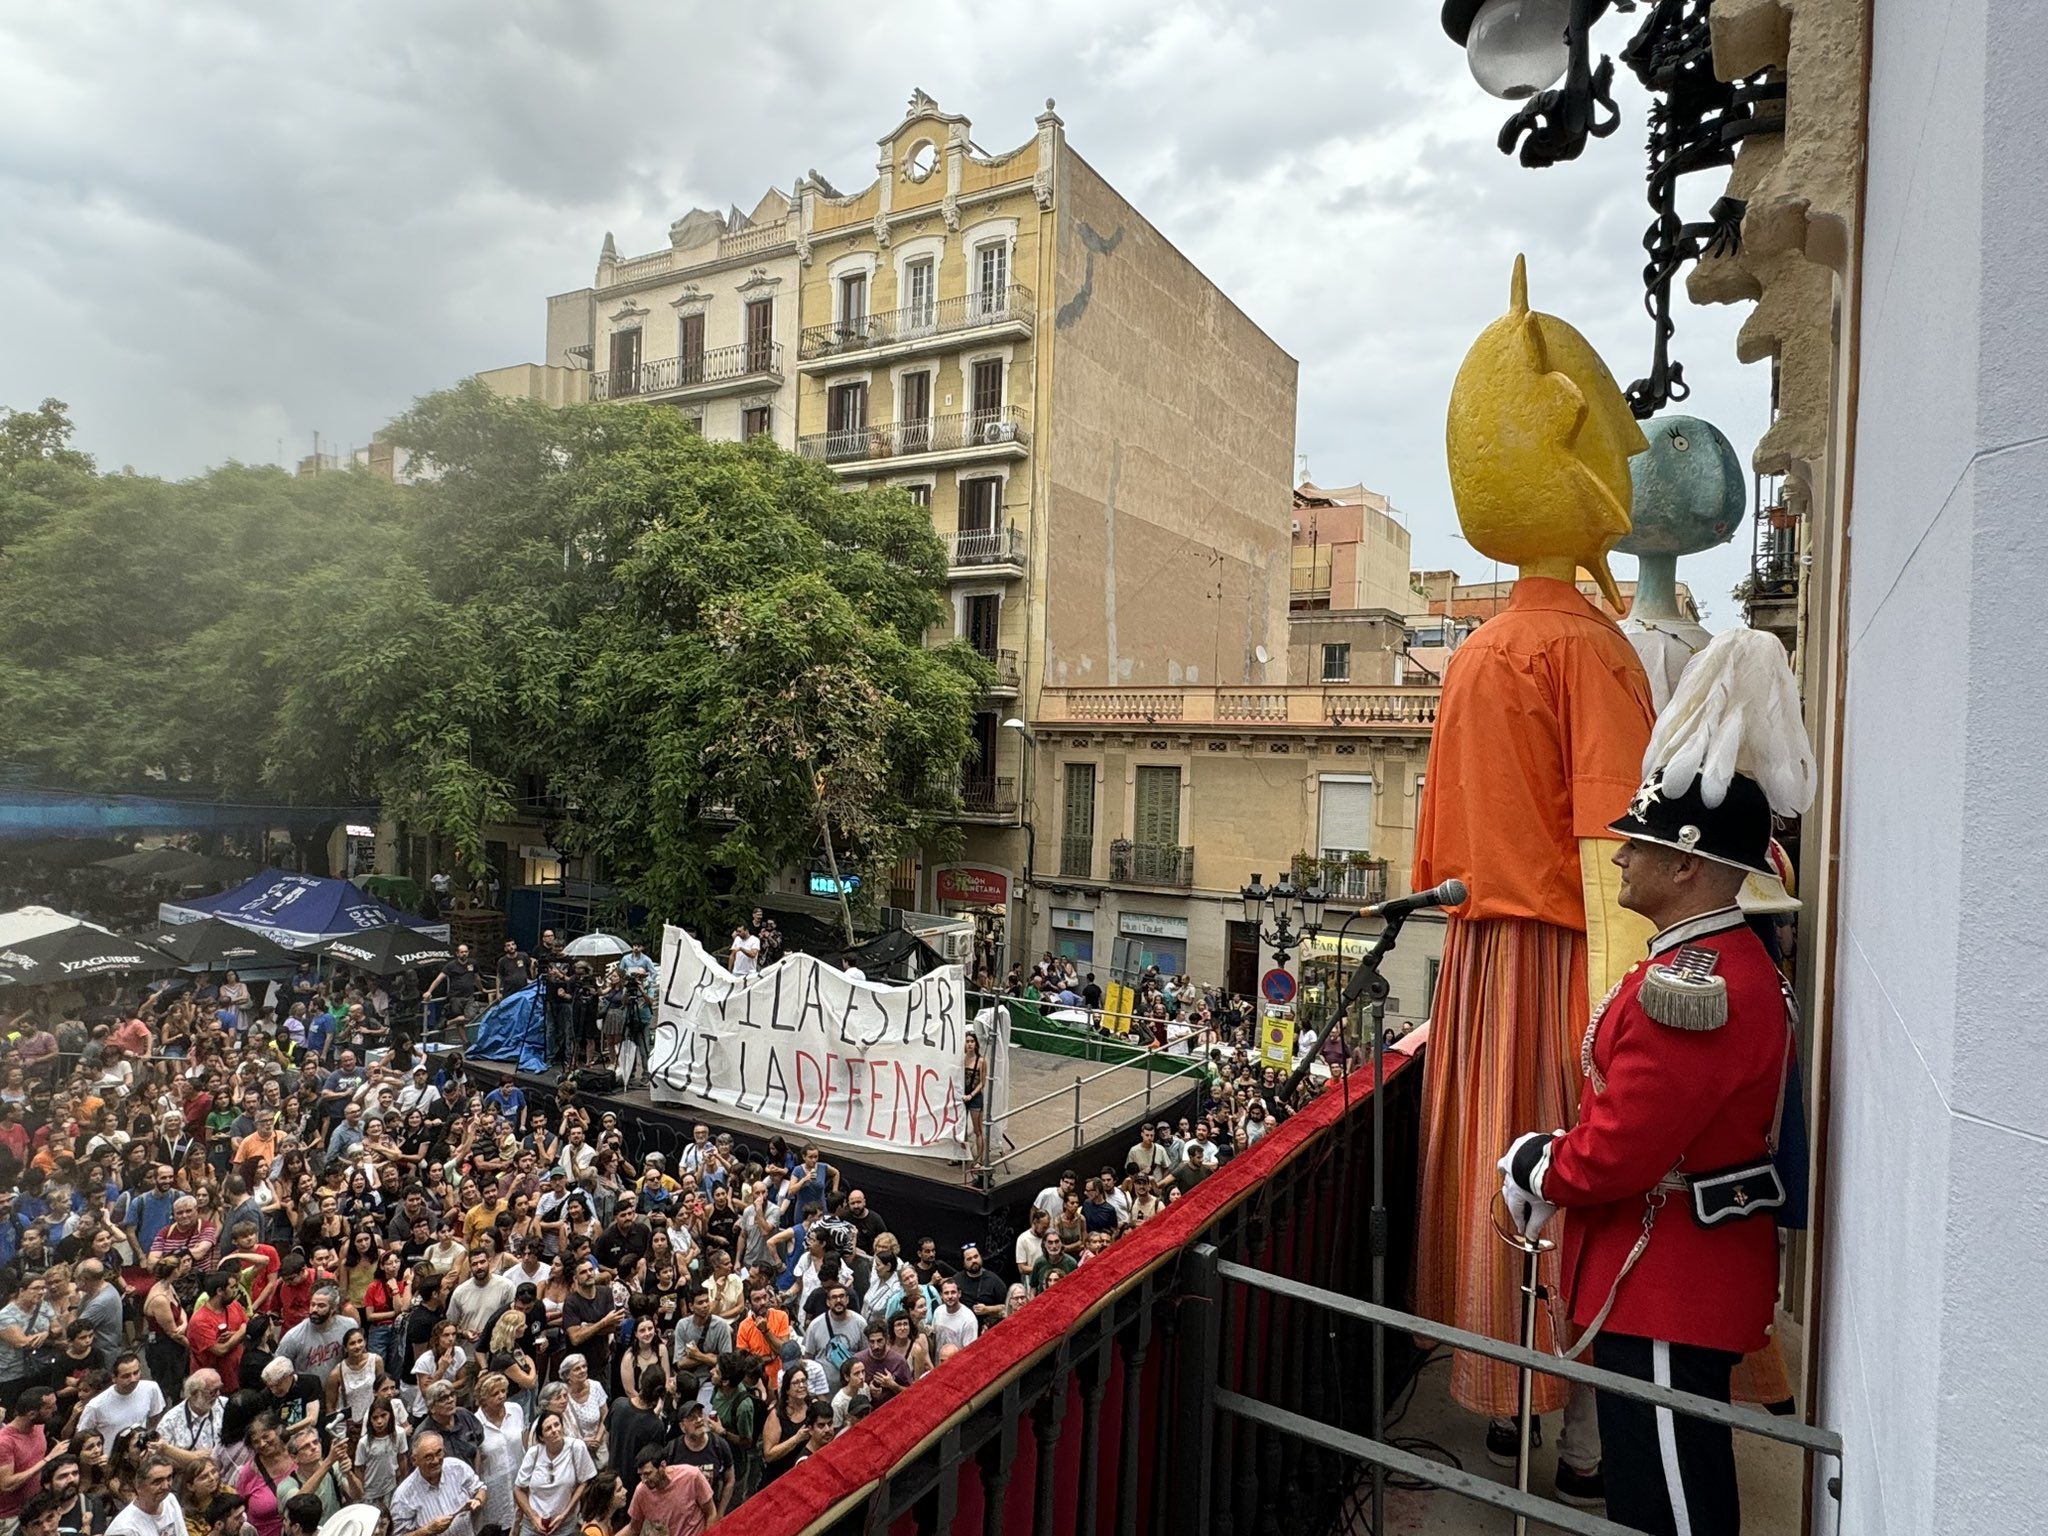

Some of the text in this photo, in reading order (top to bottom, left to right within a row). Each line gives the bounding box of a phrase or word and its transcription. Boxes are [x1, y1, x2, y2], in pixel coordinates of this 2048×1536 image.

[59, 956, 146, 973] YZAGUIRRE
[903, 977, 956, 1055] PER
[735, 1041, 788, 1120] LA
[794, 1050, 967, 1150] DEFENSA
